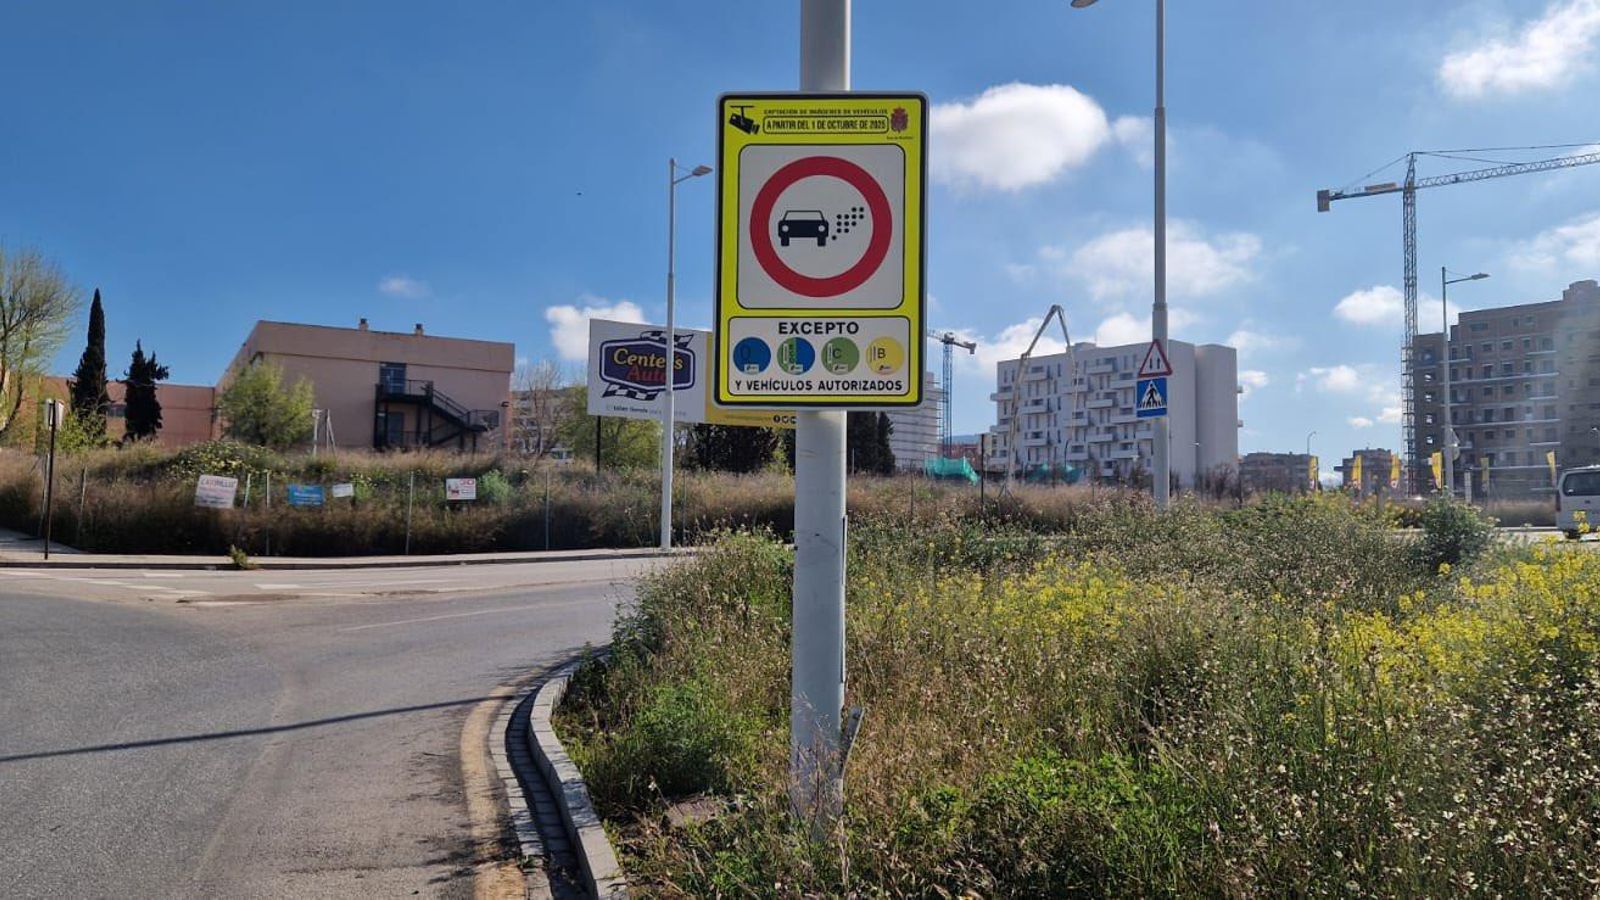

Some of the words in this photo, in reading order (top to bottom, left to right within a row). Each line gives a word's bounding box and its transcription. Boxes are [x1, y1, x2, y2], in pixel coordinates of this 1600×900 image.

[766, 120, 772, 130] A
[772, 120, 796, 130] PARTIR
[798, 120, 809, 130] DEL
[811, 120, 815, 130] 1
[817, 120, 827, 130] DE
[827, 120, 858, 130] OCTUBRE
[859, 120, 868, 130] DE
[870, 120, 886, 130] 2025
[778, 321, 860, 335] EXCEPTO
[613, 347, 684, 370] Centes
[832, 348, 842, 359] C
[877, 348, 886, 358] B
[735, 381, 742, 391] Y
[746, 378, 813, 391] VEHÍCULOS
[817, 380, 903, 391] AUTORIZADOS
